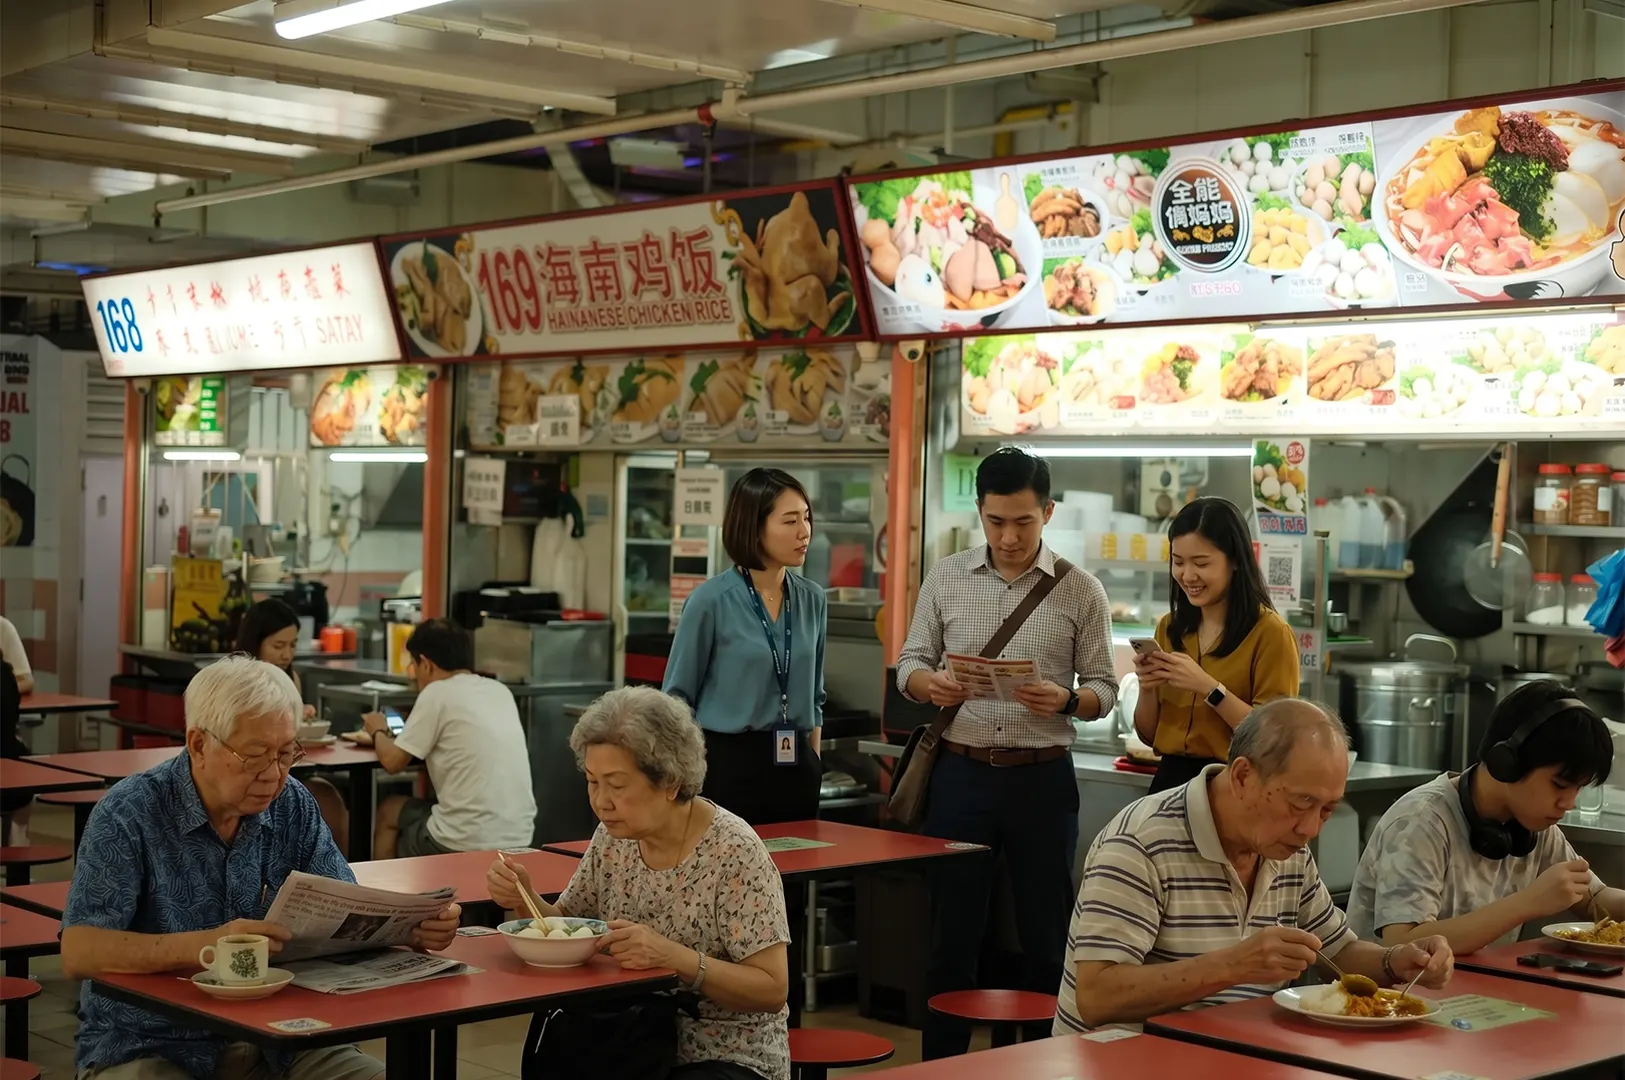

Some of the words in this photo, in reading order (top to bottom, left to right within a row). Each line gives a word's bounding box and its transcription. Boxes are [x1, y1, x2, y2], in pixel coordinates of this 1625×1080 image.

[478, 248, 541, 331] 169
[536, 229, 722, 304] 海南鸡饭
[97, 298, 143, 354] 168
[316, 314, 365, 344] SATAY
[549, 306, 624, 330] HAINANESE
[628, 299, 692, 326] CHICKEN
[696, 298, 731, 321] RICE
